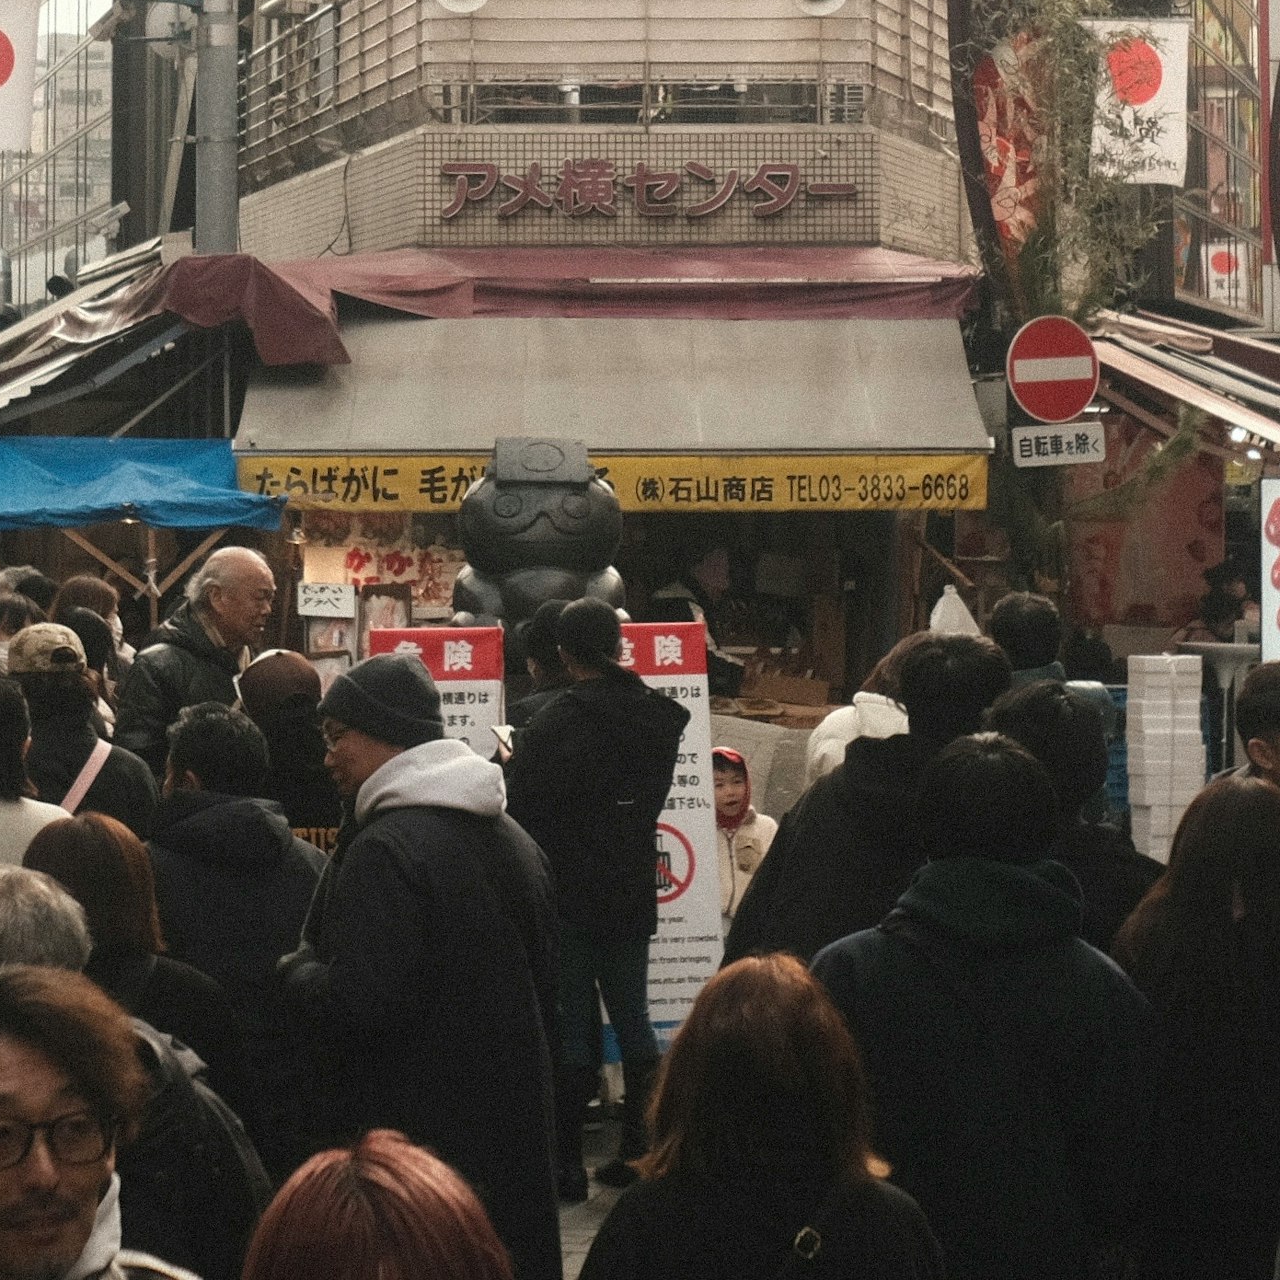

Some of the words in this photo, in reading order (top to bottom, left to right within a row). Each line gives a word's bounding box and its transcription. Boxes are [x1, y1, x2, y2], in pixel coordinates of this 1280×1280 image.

[441, 157, 858, 219] アメ横センター
[1019, 432, 1100, 459] 自転車を除く
[255, 465, 400, 506] たらばがに
